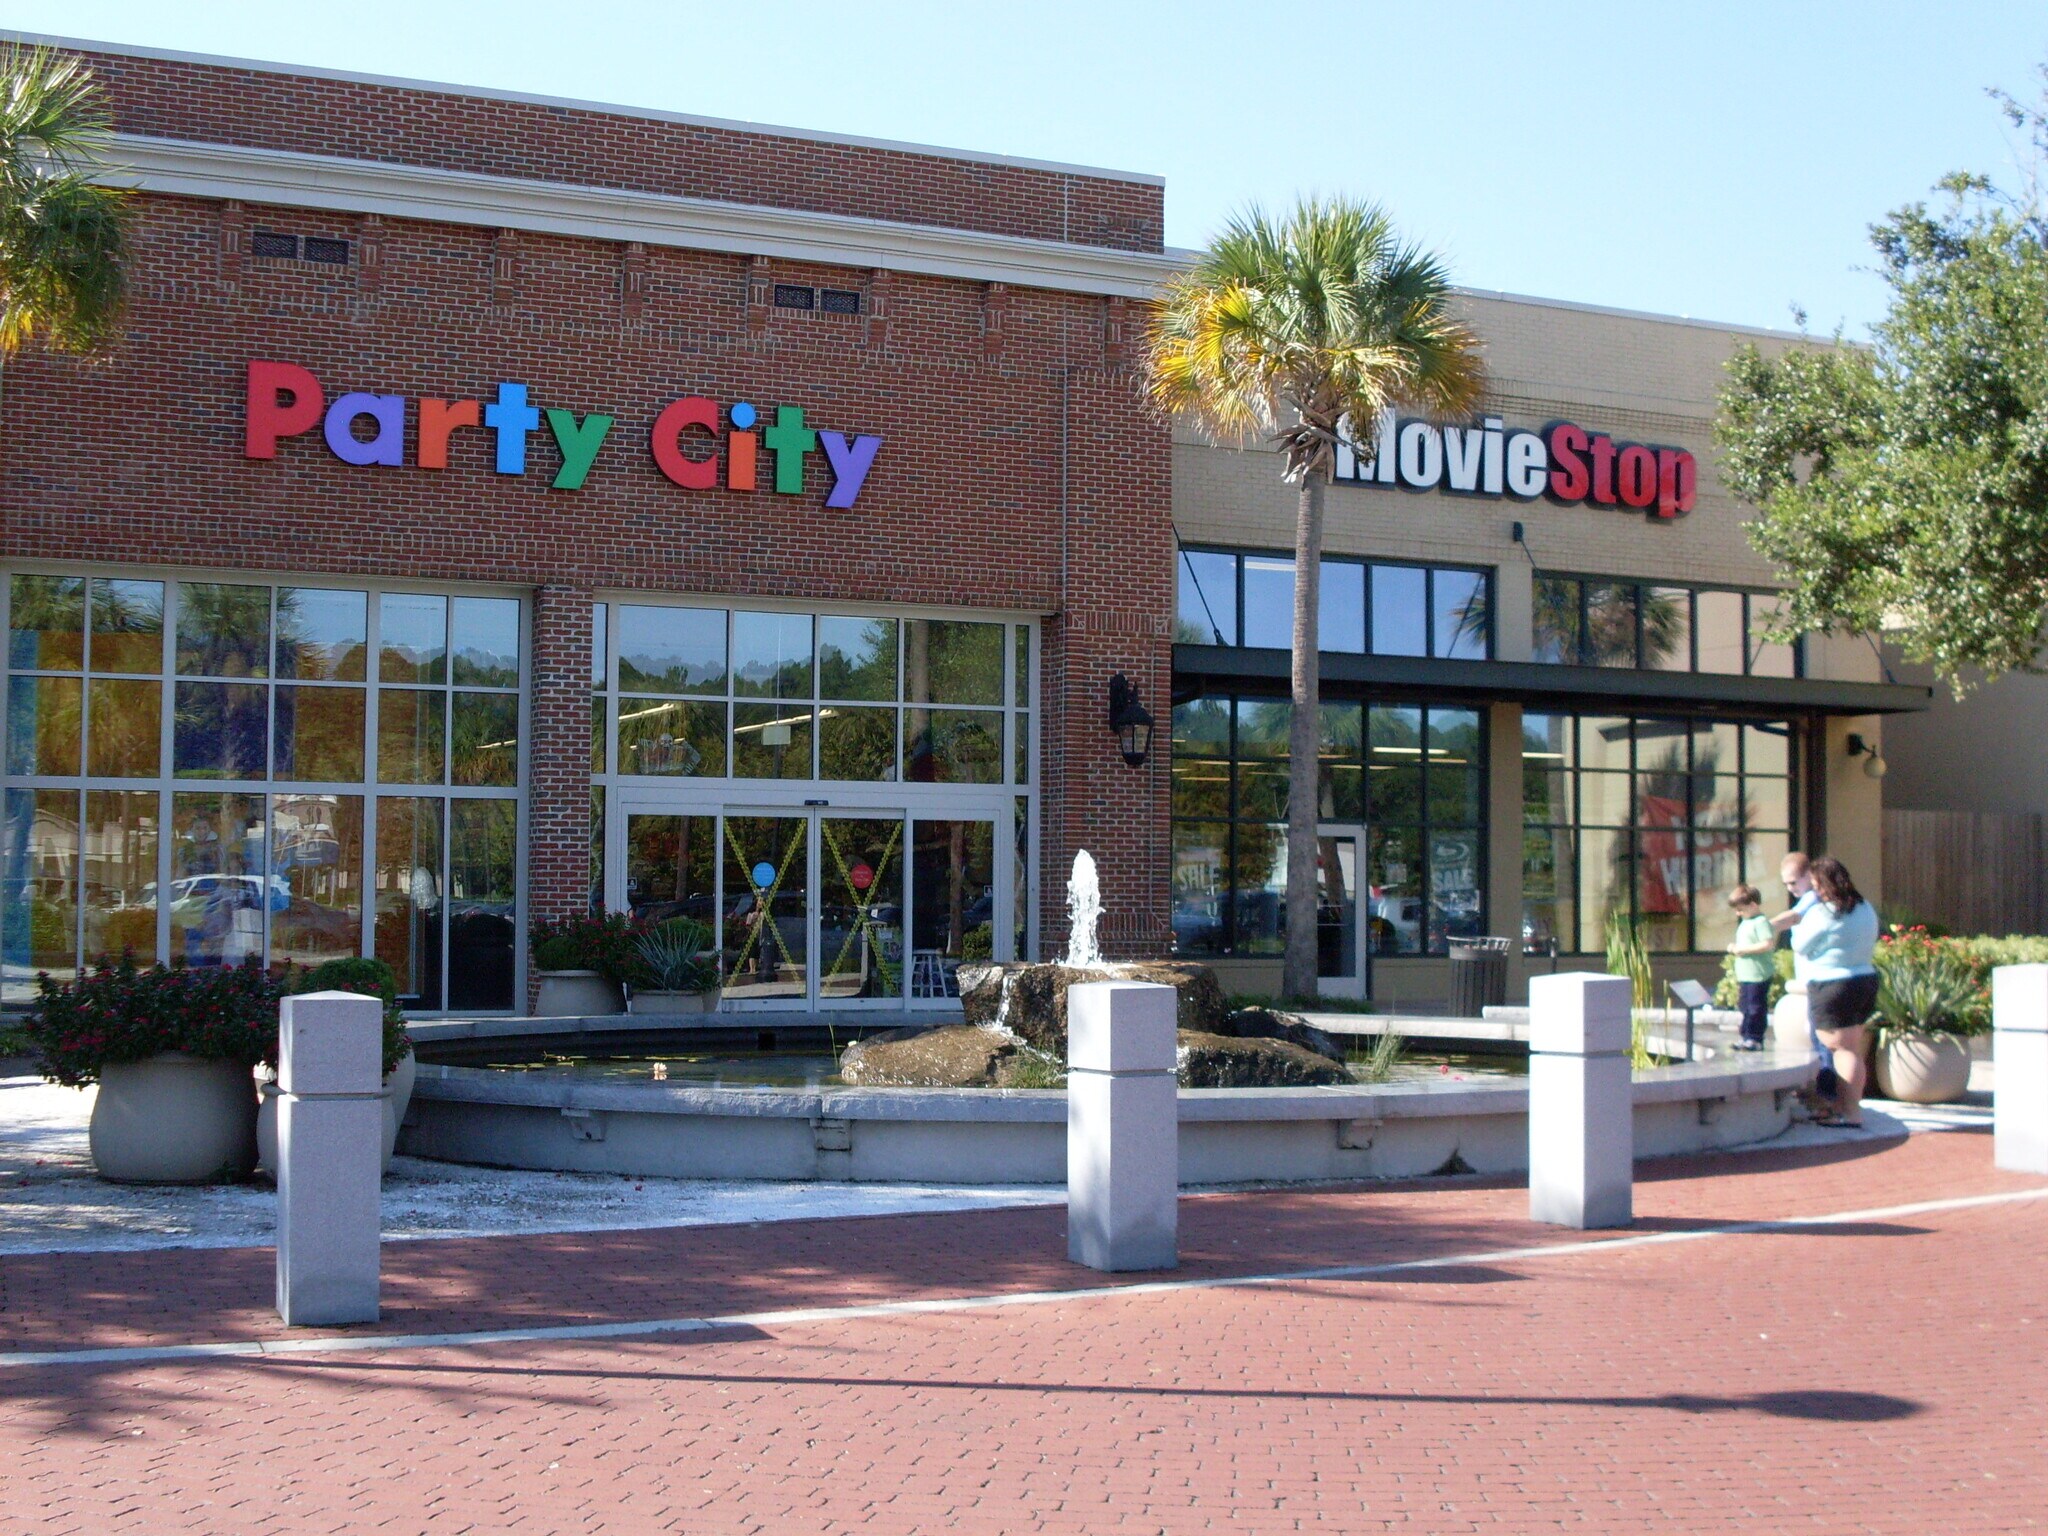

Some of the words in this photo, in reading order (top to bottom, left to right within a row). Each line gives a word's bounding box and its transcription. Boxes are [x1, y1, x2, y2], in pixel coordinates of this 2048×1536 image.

[245, 360, 614, 490] Party
[652, 396, 882, 509] City
[1335, 408, 1697, 518] MovieStop
